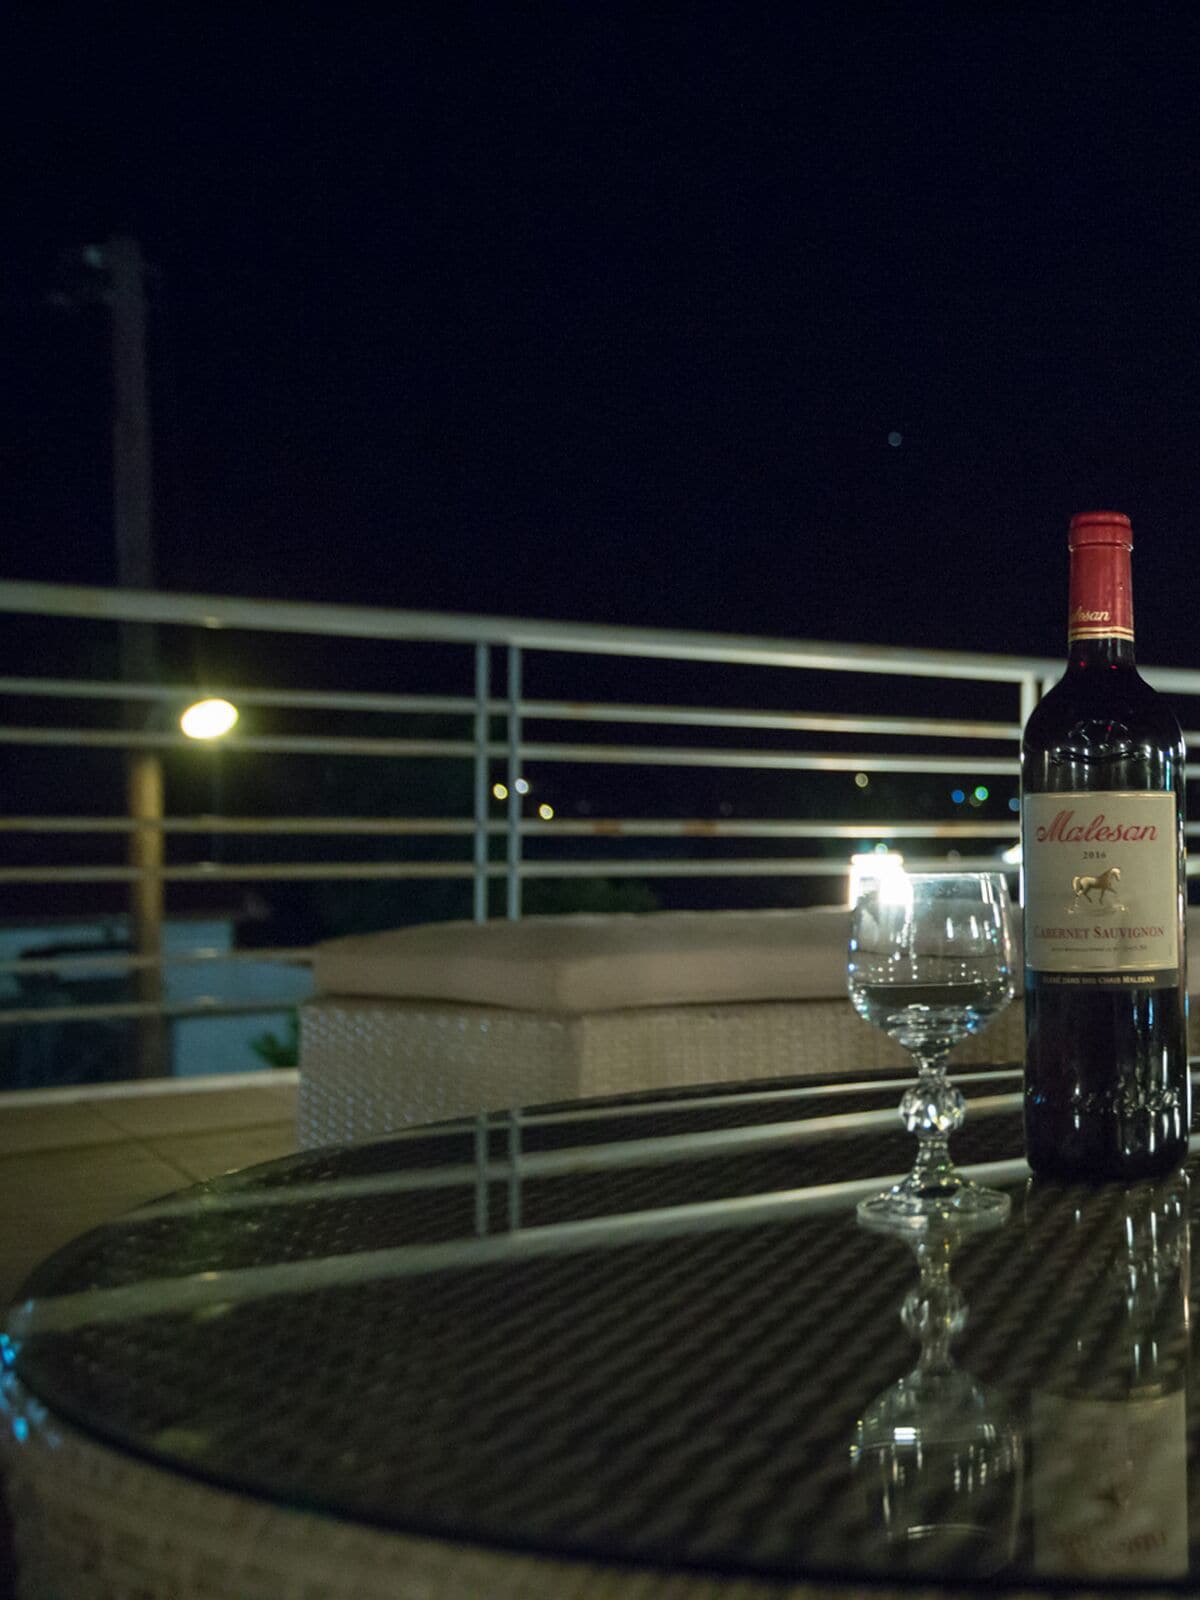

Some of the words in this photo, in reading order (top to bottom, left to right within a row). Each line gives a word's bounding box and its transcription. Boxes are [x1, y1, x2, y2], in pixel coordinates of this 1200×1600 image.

[1036, 810, 1158, 843] Malesan
[1082, 851, 1107, 860] 2016
[1093, 926, 1165, 939] SAUVIGNON
